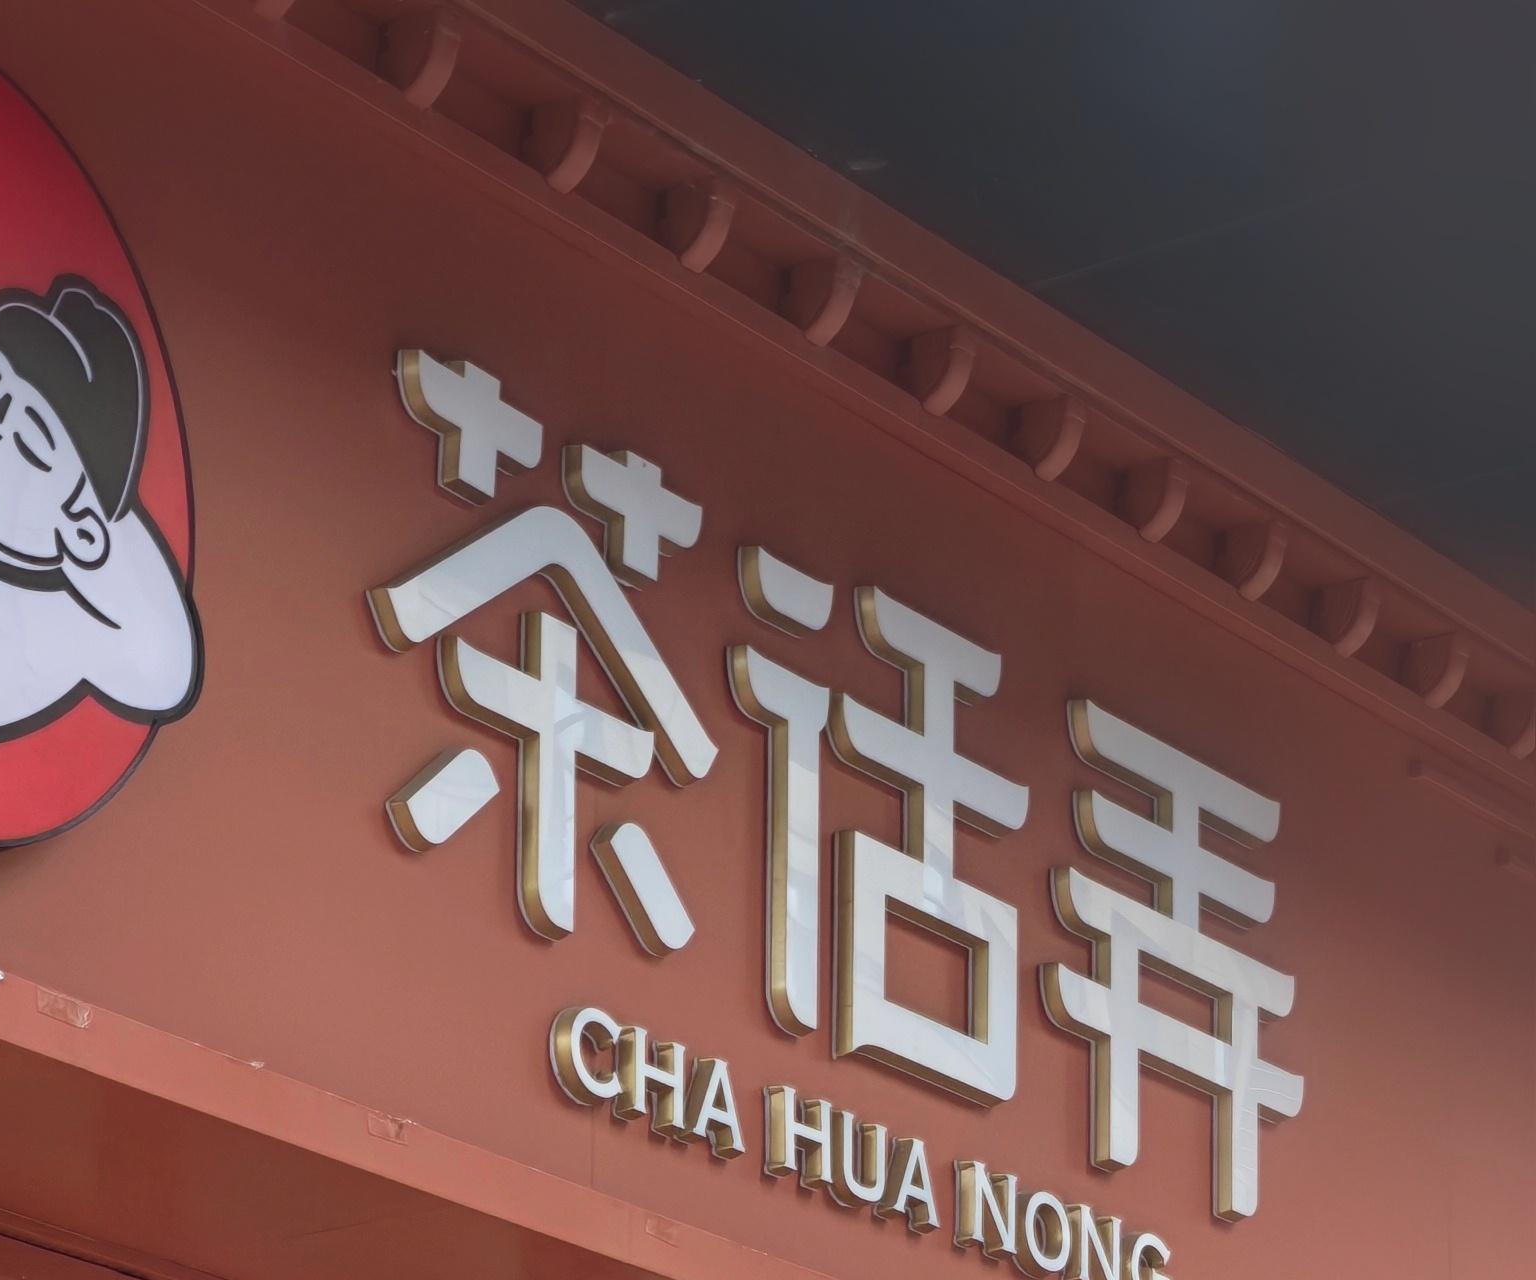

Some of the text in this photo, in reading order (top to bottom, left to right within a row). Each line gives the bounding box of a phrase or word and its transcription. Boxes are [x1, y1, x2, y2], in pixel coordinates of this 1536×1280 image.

[366, 348, 1305, 1222] 茶话弄
[547, 1005, 745, 1159] CHA
[763, 1083, 940, 1235] HUA
